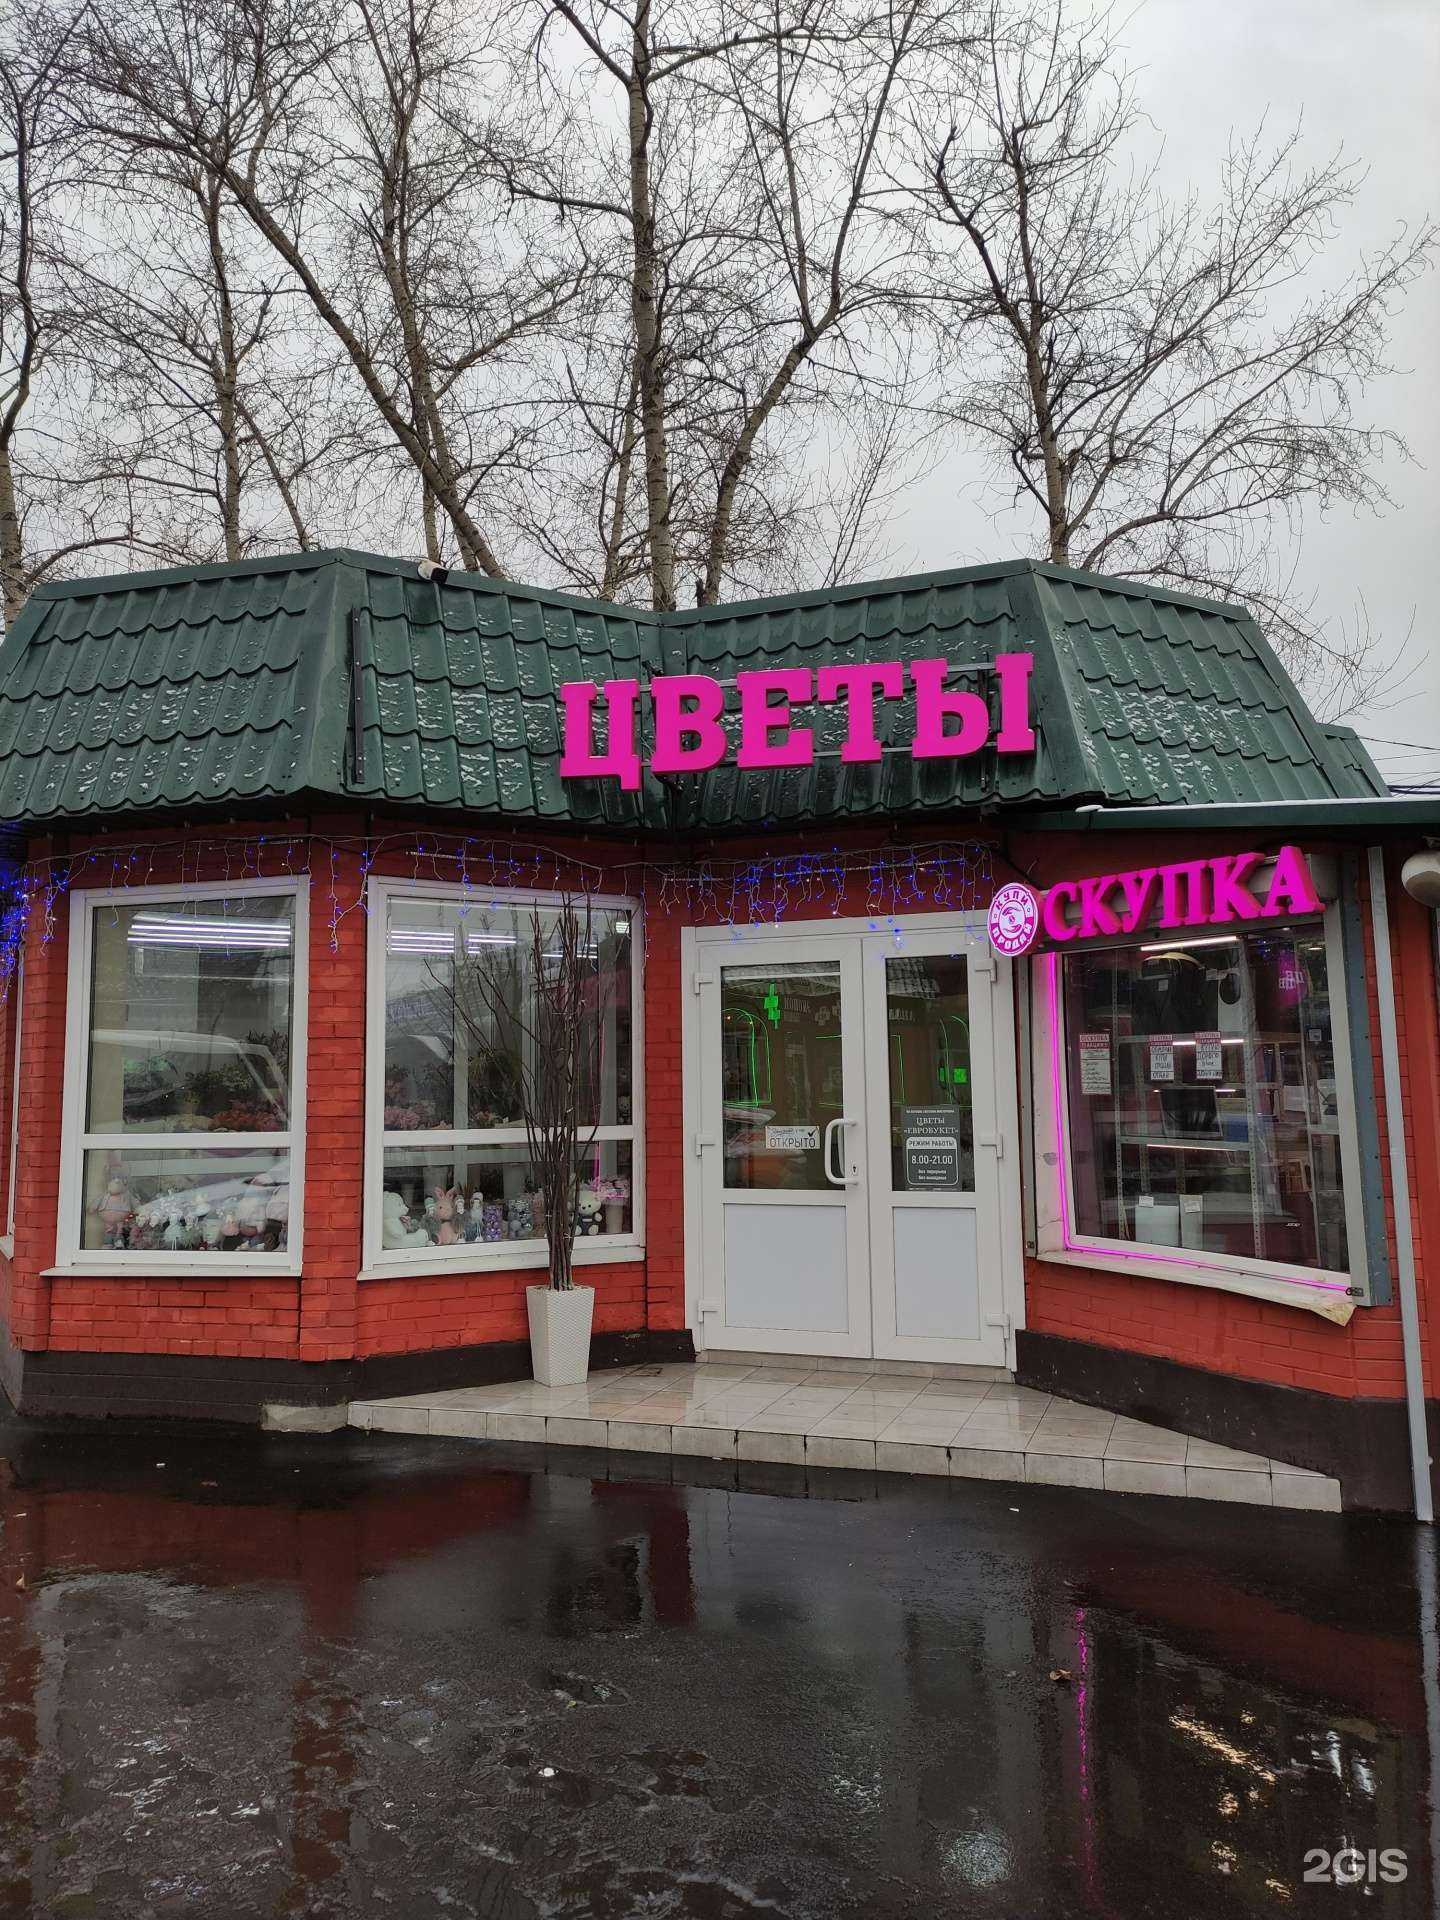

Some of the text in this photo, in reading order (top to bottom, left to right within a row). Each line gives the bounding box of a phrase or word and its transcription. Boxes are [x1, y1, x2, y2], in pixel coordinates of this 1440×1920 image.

[560, 652, 1036, 792] ЦВЕТЫ
[995, 890, 1029, 910] КУПИ
[1043, 845, 1326, 941] СКУПКА
[916, 1116, 945, 1126] ЦВЕТЫ
[770, 1137, 816, 1148] ОТКРЫТО
[911, 1155, 953, 1165] 8.00-21.00
